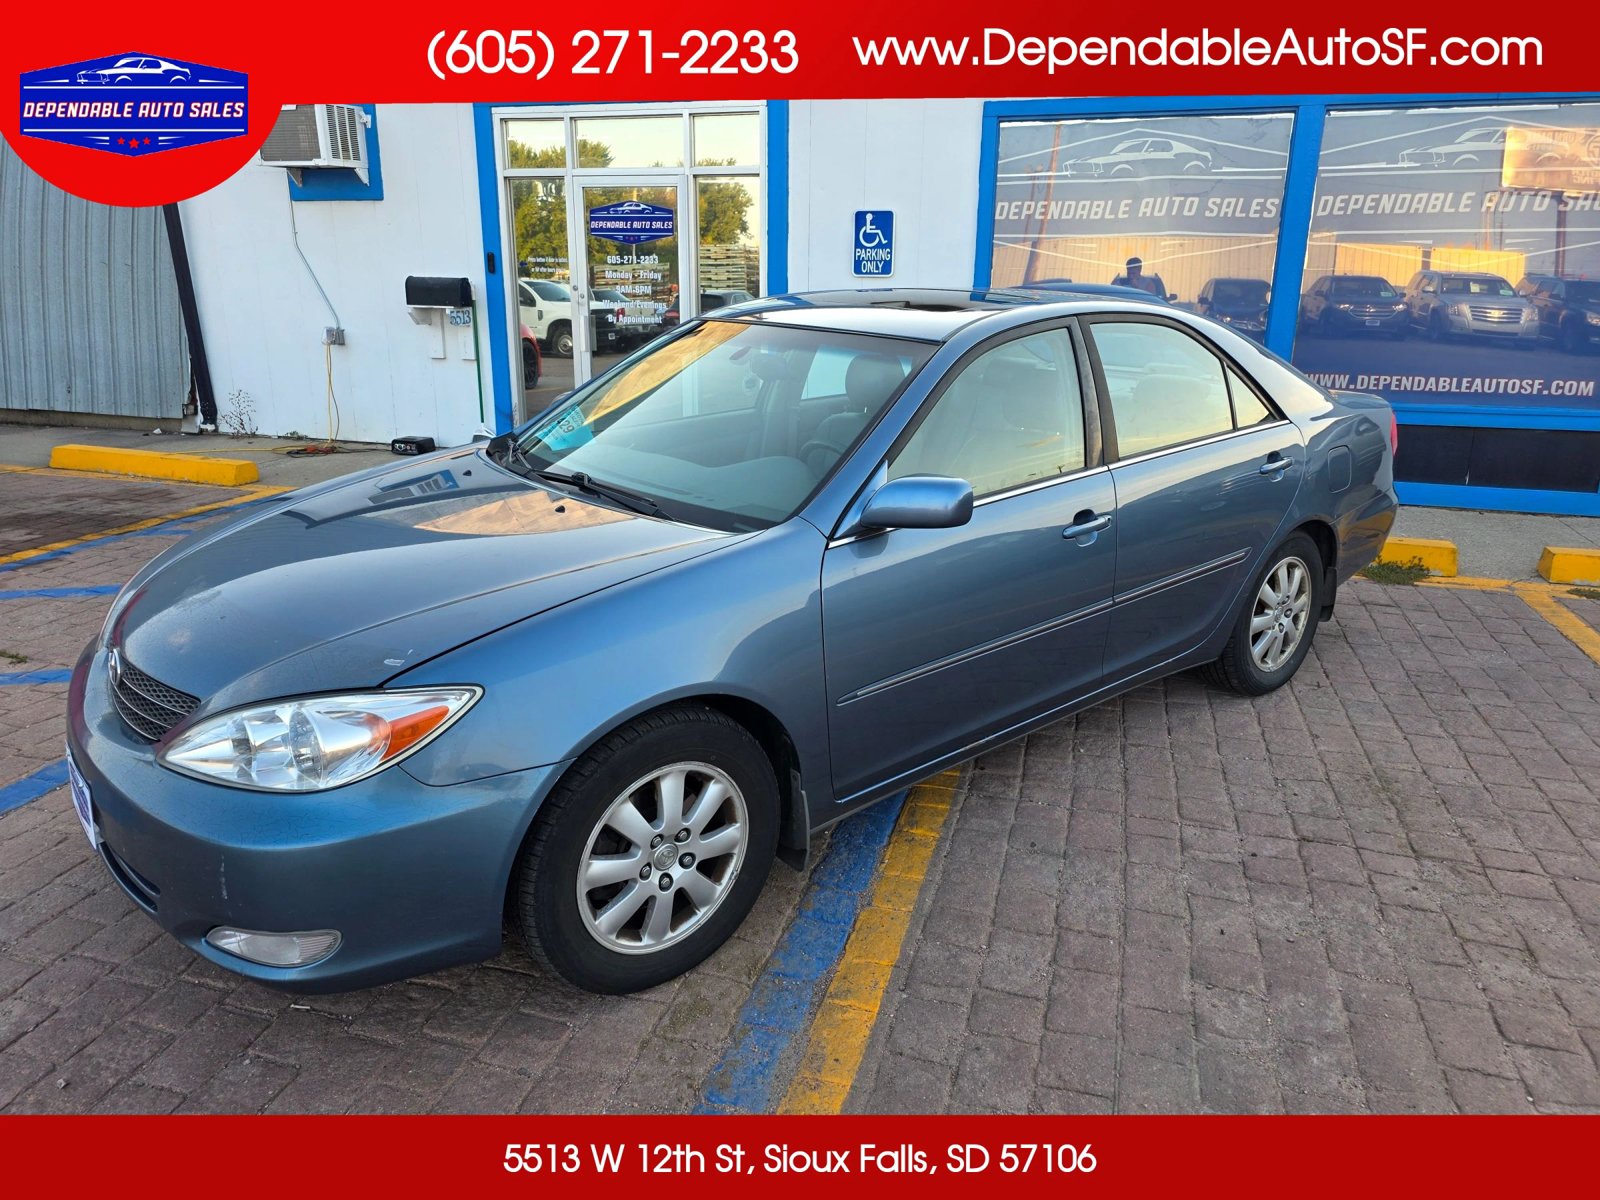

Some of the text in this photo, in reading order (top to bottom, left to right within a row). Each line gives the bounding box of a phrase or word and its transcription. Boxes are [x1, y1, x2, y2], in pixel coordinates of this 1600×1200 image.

[994, 196, 1279, 220] DEPENDABLE AUTO SALES
[1316, 192, 1476, 216] DEPENDABLE
[1481, 190, 1550, 212] AUTO
[590, 221, 673, 229] DEPENDABLE AUTO SALES
[606, 255, 659, 264] 605-271-2233
[855, 248, 891, 260] PARKING
[861, 260, 884, 273] ONLY
[605, 270, 633, 280] Monday
[639, 270, 662, 281] Friday
[449, 309, 472, 326] 5513
[618, 315, 662, 324] Appointment
